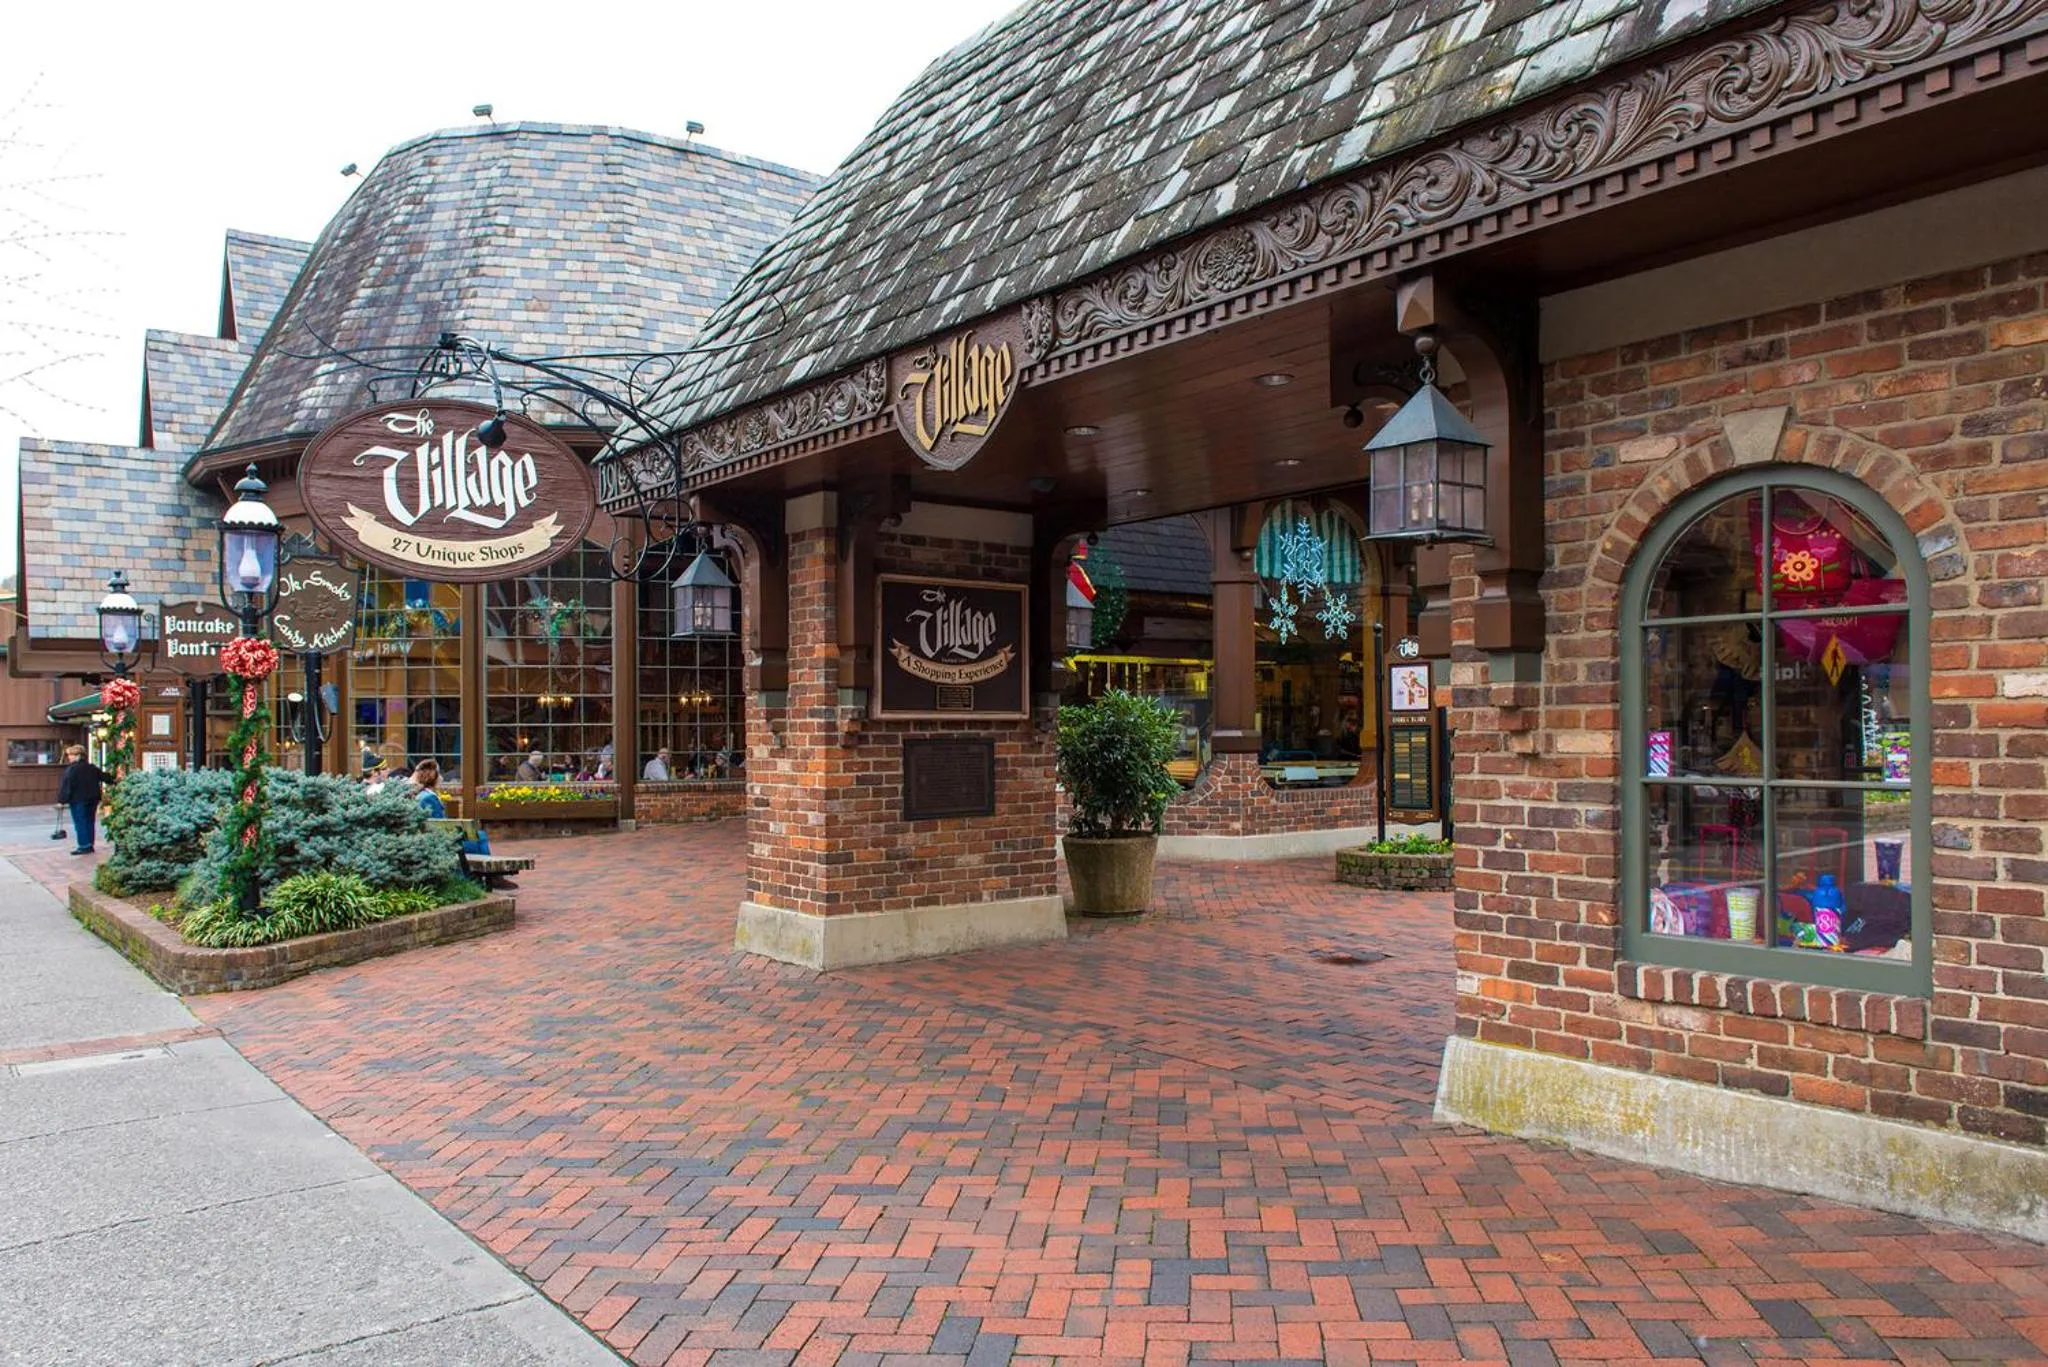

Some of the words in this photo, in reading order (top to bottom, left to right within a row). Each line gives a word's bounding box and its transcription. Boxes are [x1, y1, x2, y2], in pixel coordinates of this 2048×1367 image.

[898, 330, 1012, 451] Village
[379, 408, 435, 436] The
[353, 428, 539, 530] Village
[393, 537, 411, 553] 27
[415, 541, 475, 565] Unique
[481, 541, 525, 562] Shops
[302, 570, 352, 601] Smoky
[165, 615, 235, 635] Pancake
[274, 614, 306, 647] Candy
[309, 620, 353, 649] Kitchen
[906, 597, 997, 659] Village
[901, 654, 912, 667] A
[912, 658, 957, 681] Shopping
[958, 658, 1005, 681] Experience
